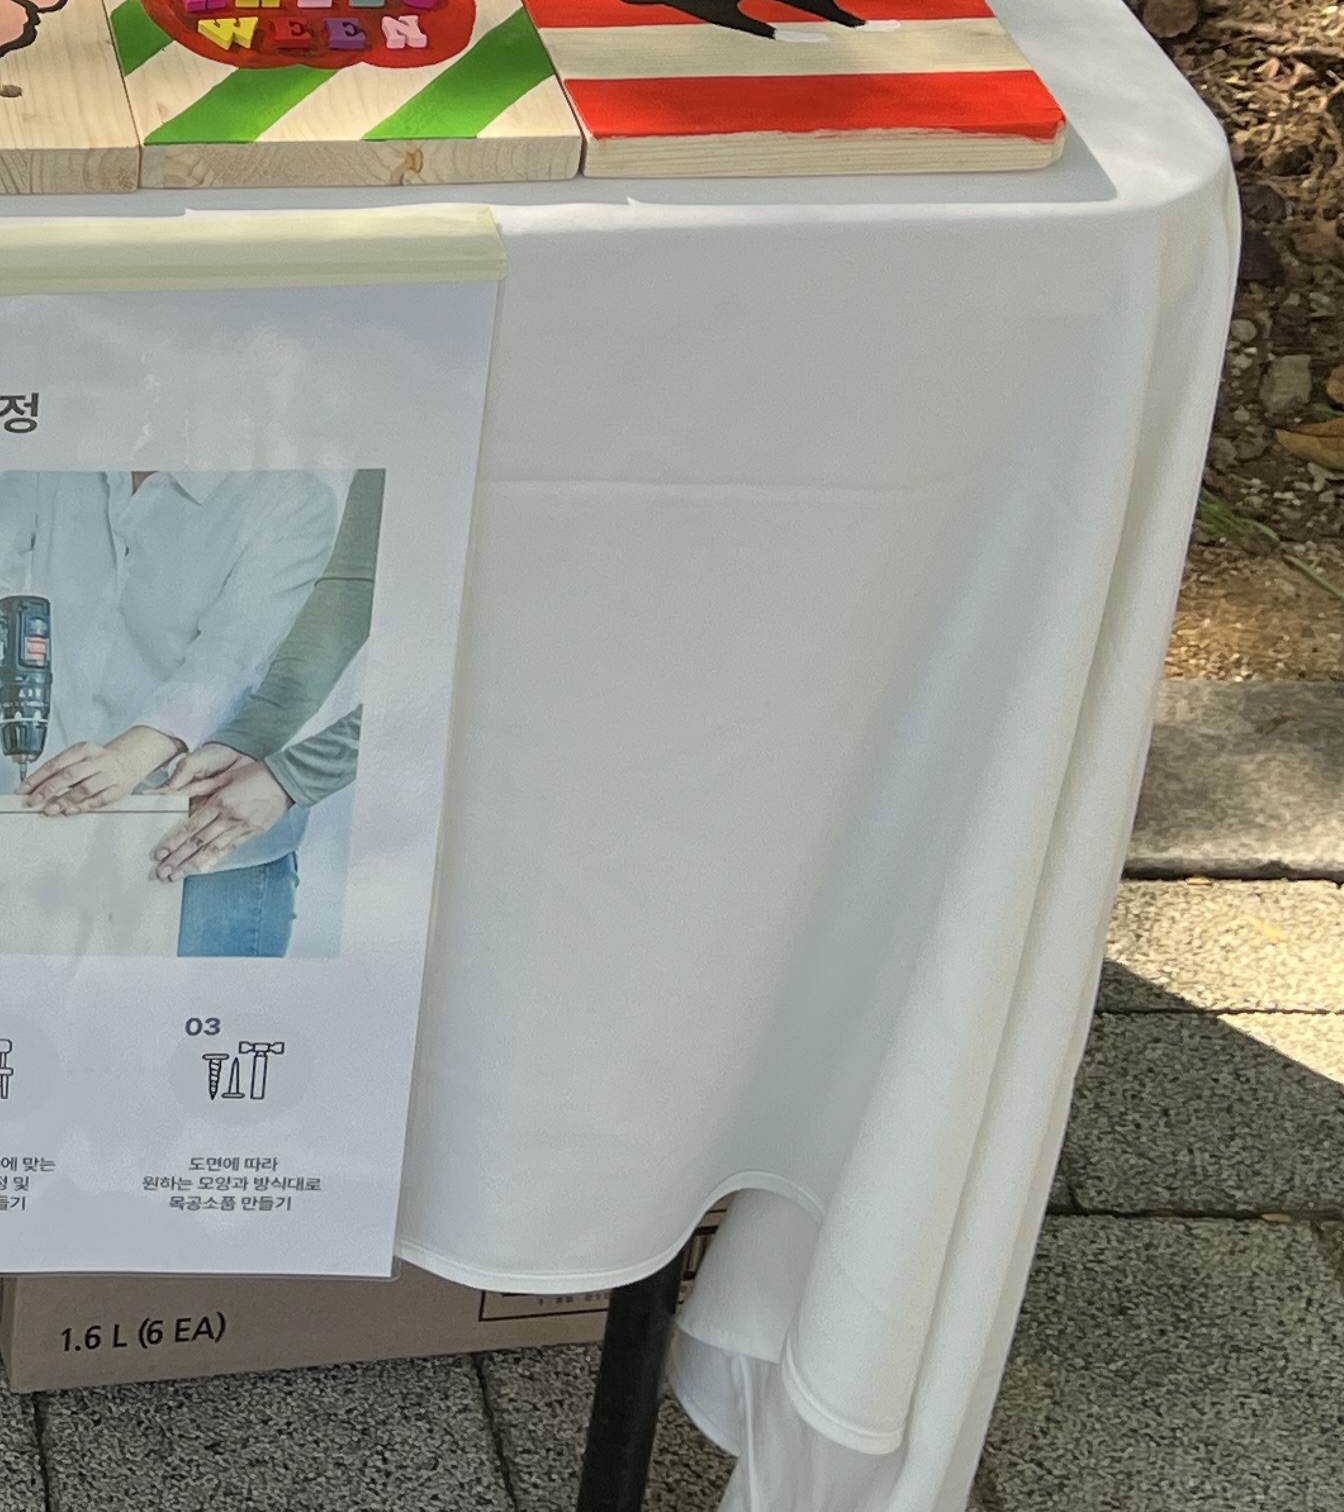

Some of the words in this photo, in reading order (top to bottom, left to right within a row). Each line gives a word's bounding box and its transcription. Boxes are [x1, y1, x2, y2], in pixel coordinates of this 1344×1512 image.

[184, 1016, 222, 1037] 03
[21, 1155, 56, 1172] 맞는
[187, 1155, 240, 1172] 도면에
[243, 1156, 279, 1173] 따라
[141, 1175, 193, 1192] 원하는
[197, 1175, 249, 1192] 모양과
[253, 1175, 322, 1192] 방식대로
[240, 1194, 292, 1211] 만들기
[60, 1325, 102, 1353] 1.6
[112, 1322, 127, 1349] L
[137, 1315, 165, 1350] (6
[174, 1312, 228, 1344] EA)
